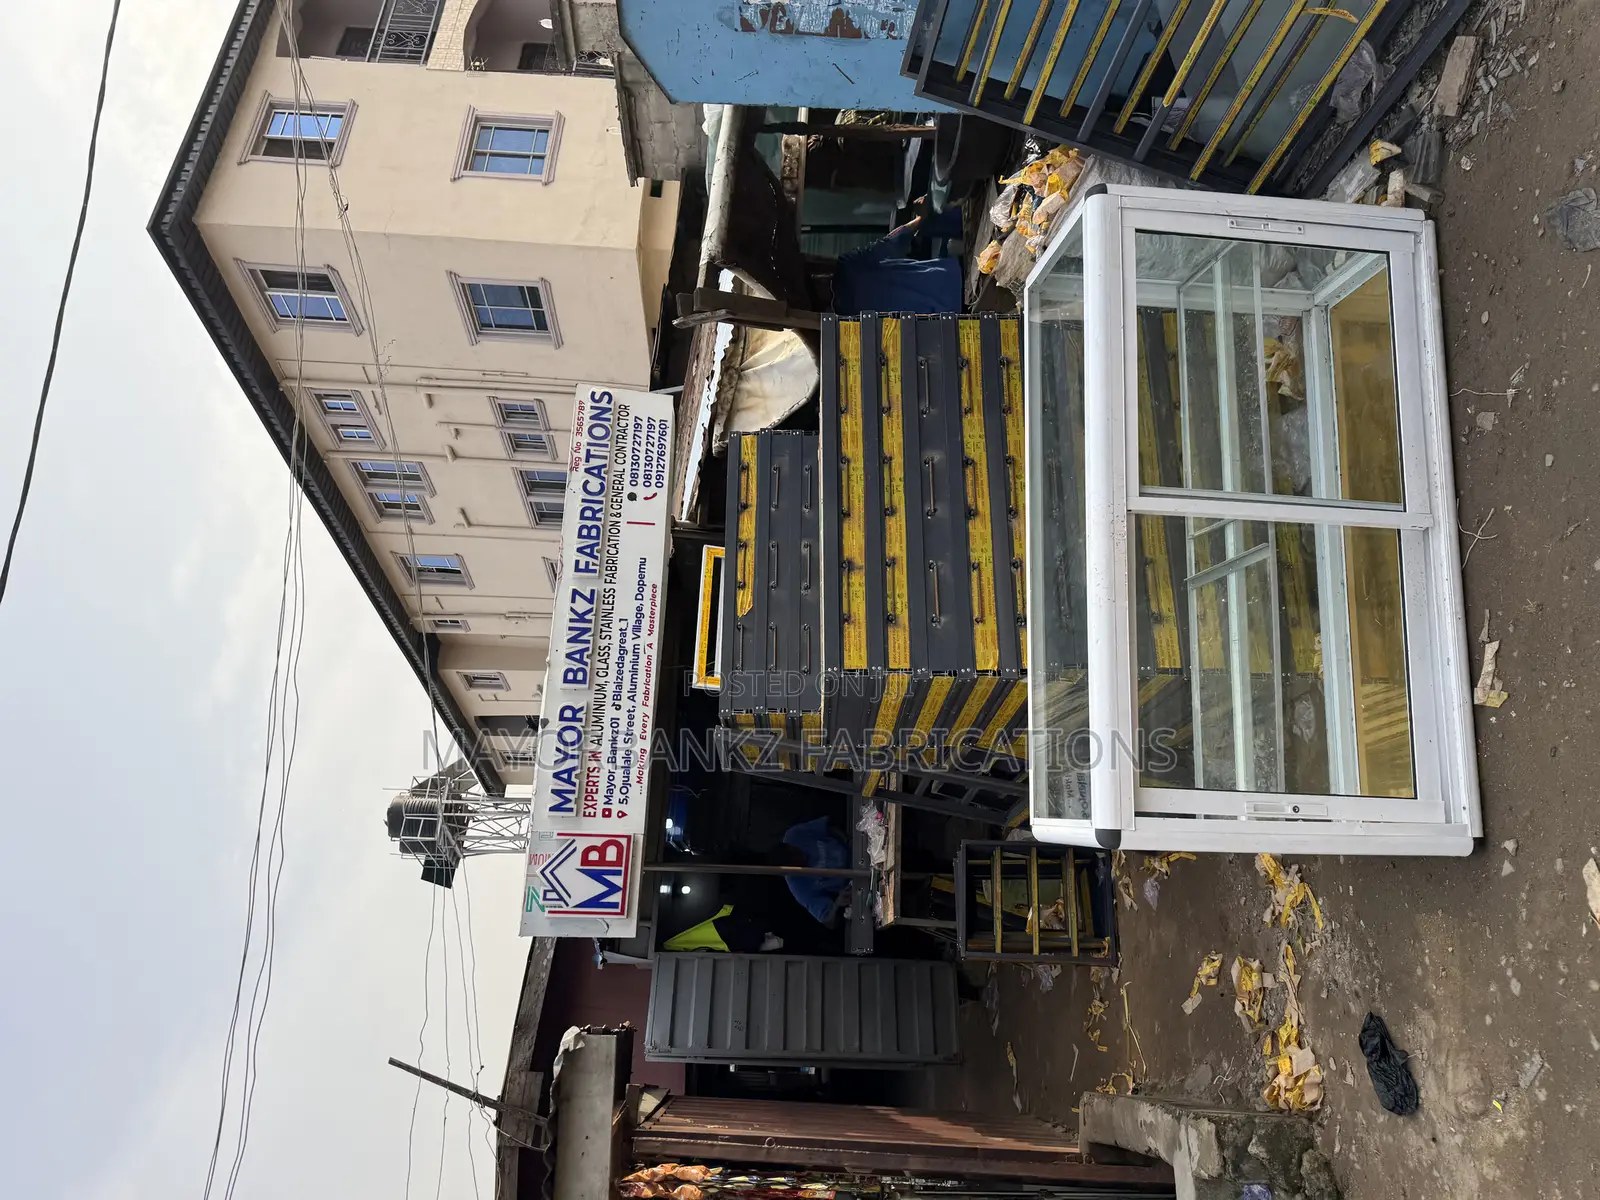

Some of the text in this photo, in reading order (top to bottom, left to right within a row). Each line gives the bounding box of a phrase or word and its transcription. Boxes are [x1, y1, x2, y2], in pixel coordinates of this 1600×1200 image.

[574, 442, 582, 453] No
[615, 404, 630, 464] CONTRACTOR
[630, 415, 643, 486] 08130727197
[643, 416, 656, 487] 08130727197
[655, 419, 668, 488] 09127697601
[572, 457, 582, 472] Reg
[611, 469, 625, 510] GENERAL
[604, 521, 621, 584] FABRICATION
[549, 391, 613, 812] MAYOR BANKZ FABRICATIONS
[635, 557, 647, 601] Dopemu
[600, 588, 615, 640] STAINLESS
[632, 604, 644, 640] Village,
[648, 584, 657, 636] Masterpiece
[596, 643, 613, 677] GLASS,
[628, 644, 640, 702] Aluminium
[642, 655, 652, 707] Fabrication
[590, 681, 610, 746] ALUMINIUM,
[624, 706, 637, 744] Street,
[640, 713, 649, 740] Every
[589, 751, 601, 761] IN
[583, 767, 601, 818] EXPERTS
[572, 839, 624, 909] MB
